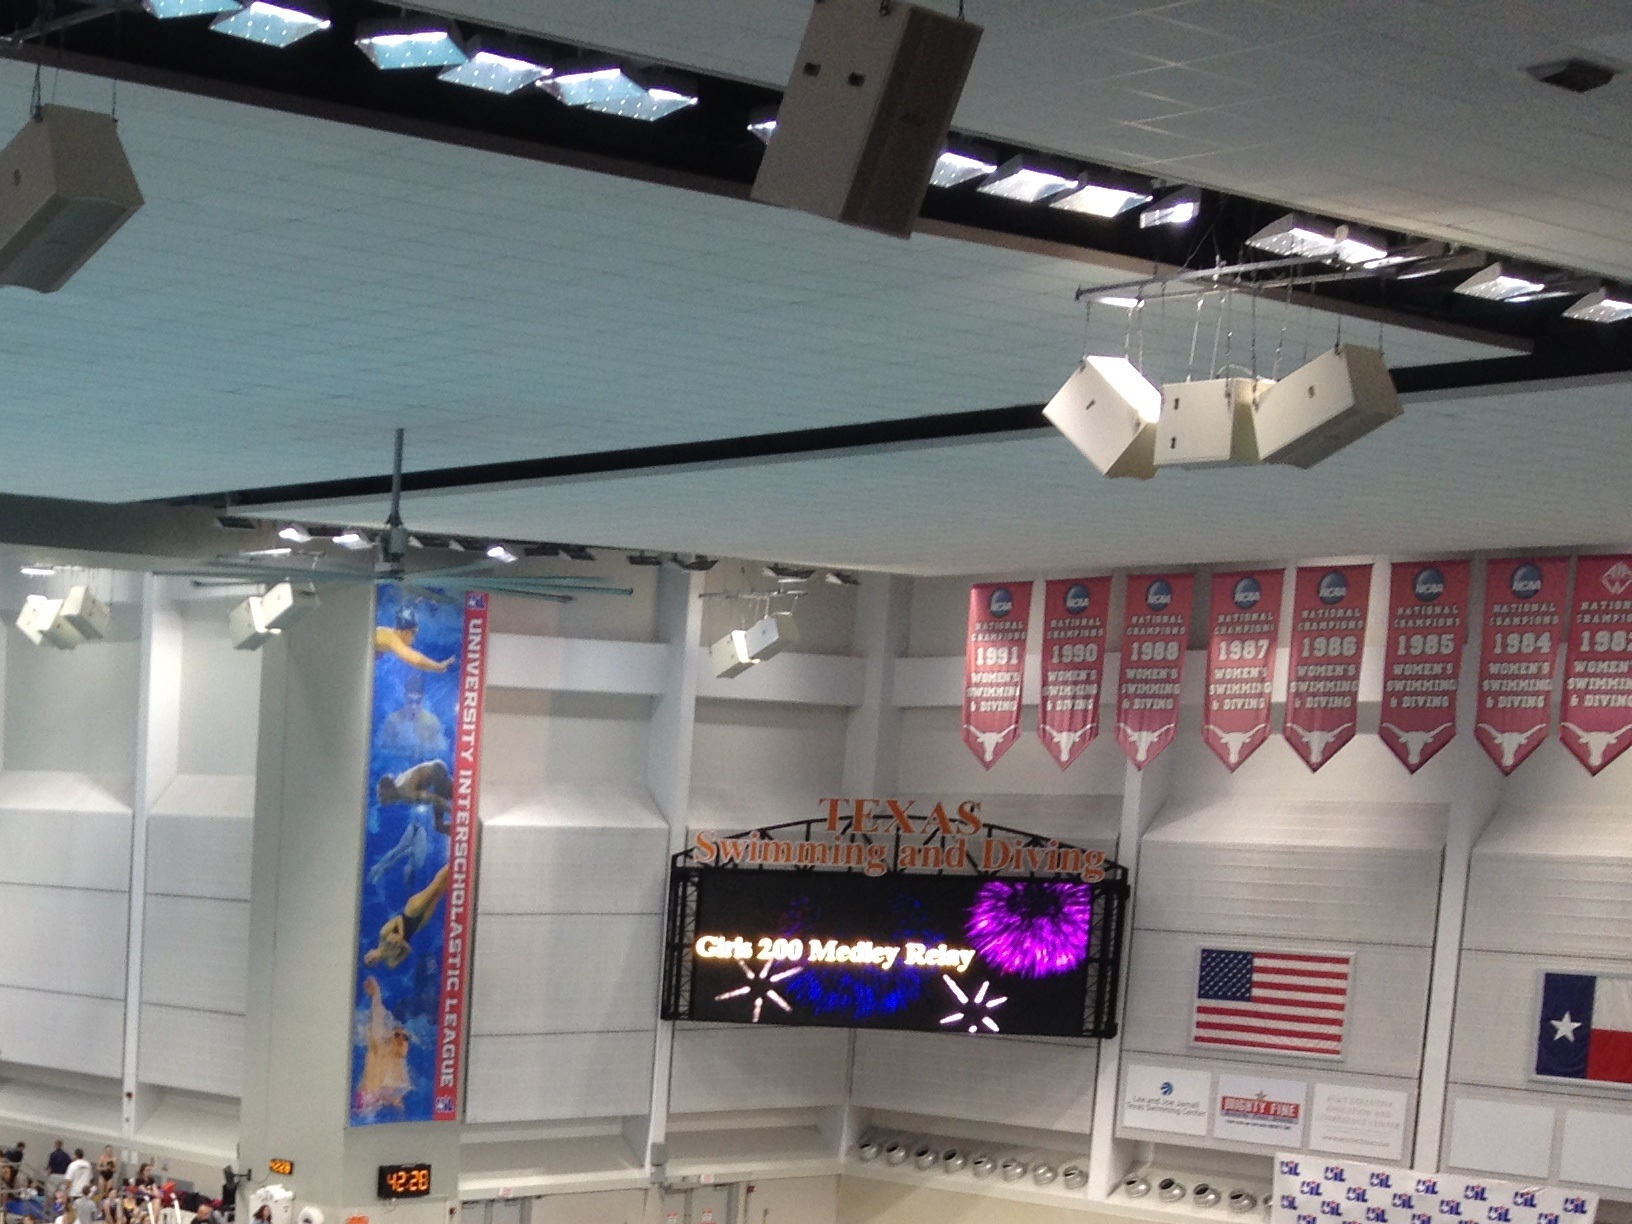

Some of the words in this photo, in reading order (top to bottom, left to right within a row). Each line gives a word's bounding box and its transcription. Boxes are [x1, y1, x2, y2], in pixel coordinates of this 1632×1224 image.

[1581, 601, 1632, 610] NATION
[1577, 614, 1632, 623] CHAMPIO
[1302, 636, 1357, 657] 1986
[1397, 634, 1455, 656] 1985
[1494, 632, 1551, 653] 1984
[976, 646, 1019, 665] 1991
[1051, 644, 1098, 663] 1990
[1130, 641, 1180, 661] 1988
[1219, 639, 1269, 661] 1987
[1297, 664, 1356, 676] WOMEN'S
[1393, 663, 1453, 674] WOMEN'S
[1489, 662, 1550, 674] WOMEN'S
[1574, 660, 1632, 673] WOMEN
[971, 671, 1020, 682] WOMEN'S
[1048, 670, 1097, 681] WOMEN'S
[1126, 668, 1178, 679] WOMEN'S
[1214, 667, 1267, 679] WOMEN'S
[461, 618, 483, 762] UNIVERSITY
[1042, 684, 1098, 695] SWIMMING
[1122, 683, 1181, 694] SWIMMING
[1209, 682, 1272, 694] SWIMMING
[1290, 680, 1358, 692] SWIMMING
[1387, 680, 1457, 691] SWIMMING
[1482, 679, 1553, 691] SWIMMING
[1567, 678, 1632, 690] SWIMMIN
[967, 686, 1020, 697] SWIMMING
[981, 701, 1017, 711] DIVING
[1057, 699, 1093, 710] DIVING
[1134, 699, 1173, 709] DIVING
[1223, 697, 1265, 710] DIVING
[1305, 696, 1352, 708] DIVING
[1402, 696, 1449, 707] DIVING
[1498, 696, 1545, 707] DIVING
[819, 798, 983, 835] TEXAS
[692, 830, 888, 876] Swimming
[899, 837, 966, 871] and
[981, 839, 1106, 882] Diving
[446, 770, 472, 991] INTERSCHOLASTIC
[695, 935, 753, 960] Girls
[757, 937, 804, 961] 200
[808, 940, 900, 970] Medley
[905, 941, 977, 972] Relay
[439, 998, 458, 1088] LEAGUE
[1224, 1098, 1266, 1114] MIGHTY
[1269, 1103, 1297, 1116] FINE
[386, 1169, 429, 1192] 42:28
